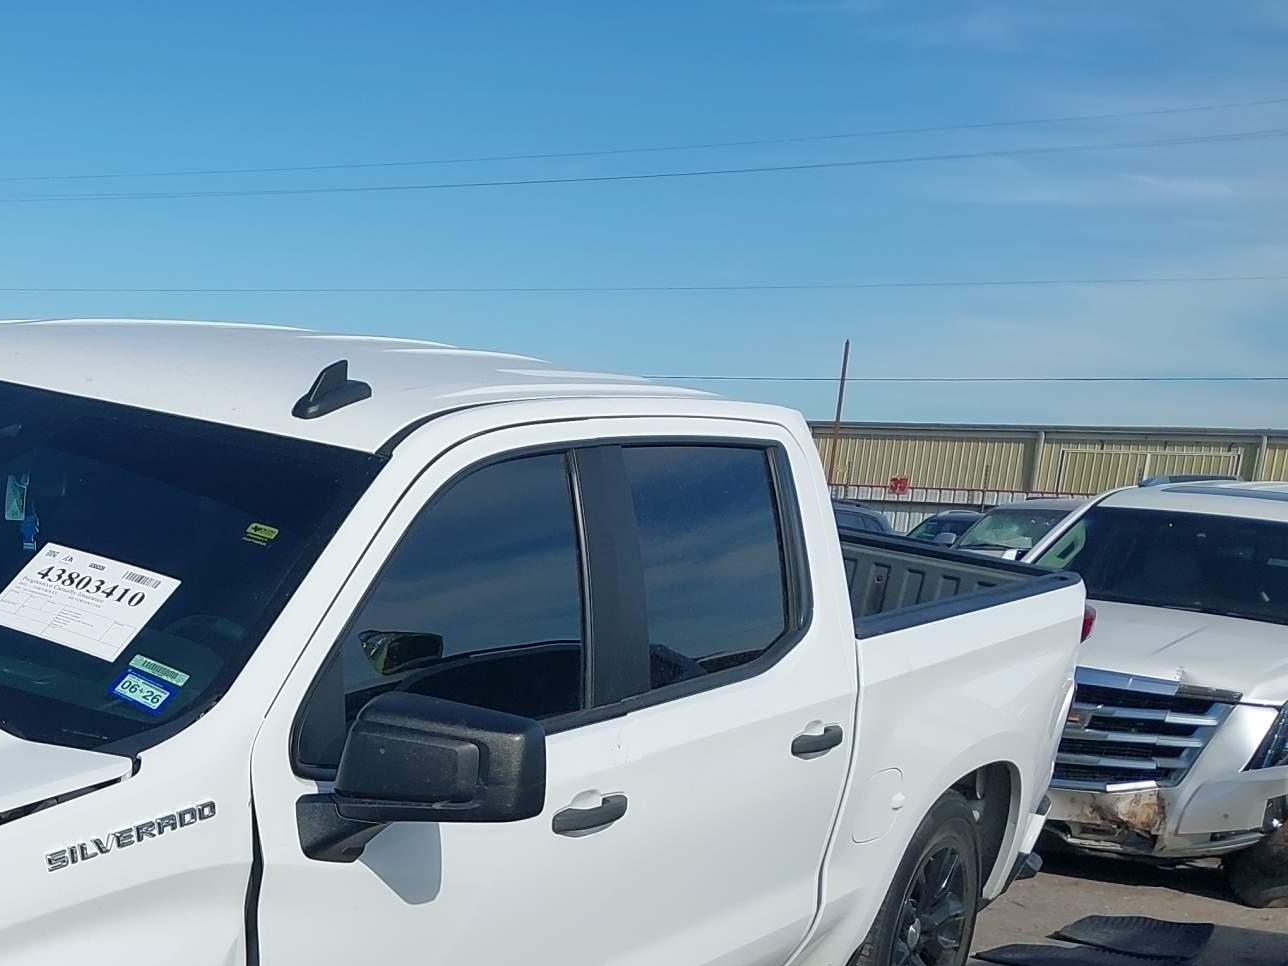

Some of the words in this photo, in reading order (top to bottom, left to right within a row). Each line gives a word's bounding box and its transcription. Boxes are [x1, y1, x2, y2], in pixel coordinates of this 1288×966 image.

[37, 565, 146, 607] 43803410
[121, 680, 140, 694] 06
[142, 689, 163, 704] 26
[46, 800, 217, 872] SILVERADO
